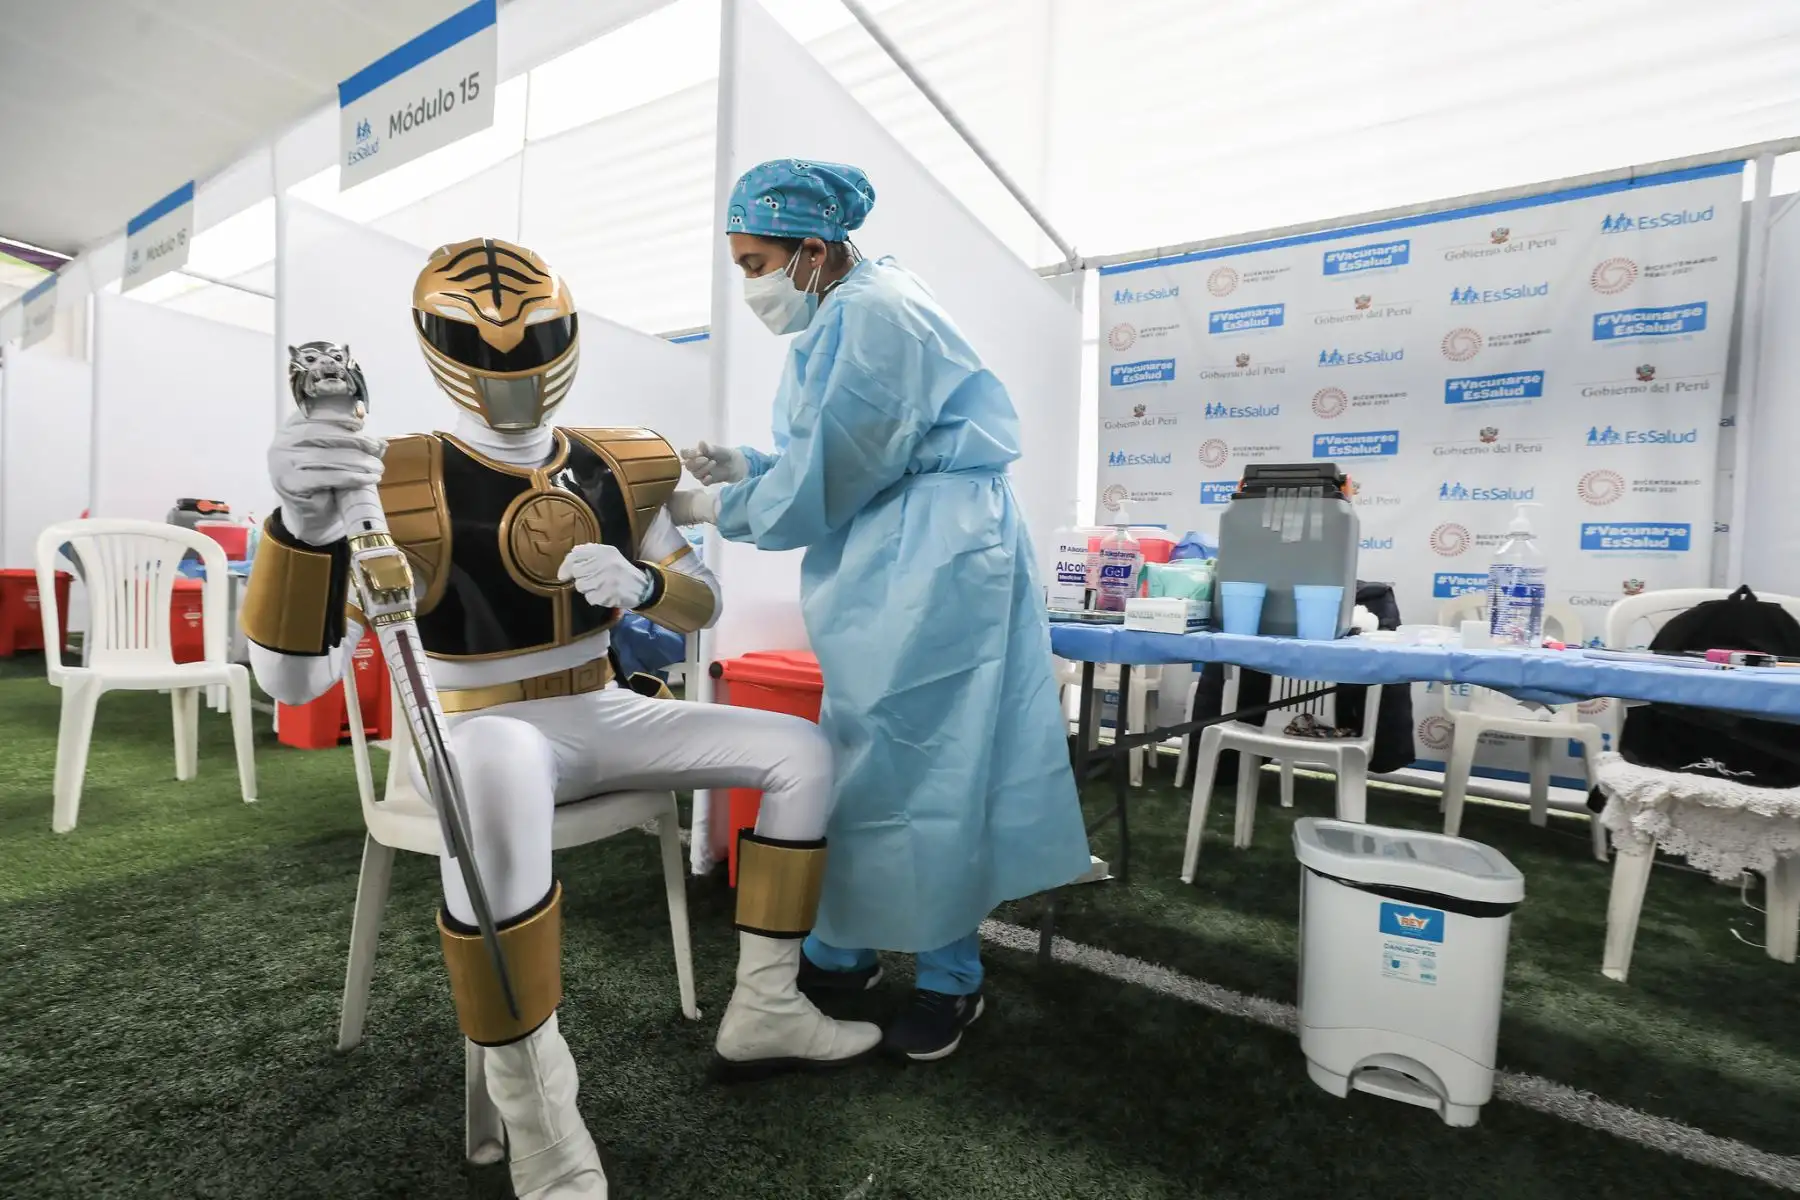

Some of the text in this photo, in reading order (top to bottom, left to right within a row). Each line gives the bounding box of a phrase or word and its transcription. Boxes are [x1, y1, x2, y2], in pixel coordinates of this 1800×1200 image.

[388, 71, 480, 140] Módulo 15
[347, 136, 379, 166] EsSalud
[1638, 205, 1714, 230] EsSalud
[1326, 244, 1407, 263] #Vacunarse
[1445, 247, 1500, 262] Gobierno
[1504, 242, 1524, 254] del
[1338, 255, 1393, 272] EsSalud
[1136, 285, 1180, 303] EsSalud
[1483, 281, 1549, 303] EsSalud
[1212, 307, 1282, 324] #Vacunarse
[1223, 316, 1270, 332] EsSalud
[1314, 313, 1363, 325] Gobierno
[1366, 309, 1383, 319] del
[1598, 306, 1704, 327] #Vacunarse
[1614, 319, 1684, 336] EsSalud
[1347, 347, 1404, 365] EsSalud
[1112, 361, 1174, 376] #Vacunarse
[1200, 370, 1243, 380] Gobierno
[1246, 367, 1260, 377] del
[1122, 371, 1163, 384] EsSalud
[1448, 374, 1542, 392] #Vacunarse
[1463, 384, 1525, 401] EsSalud
[1581, 378, 1711, 399] Gobierno del Perú
[1230, 404, 1281, 418] EsSalud
[1104, 420, 1141, 430] Gobierno
[1142, 417, 1155, 427] del
[1316, 433, 1397, 446] #Vacunarse
[1625, 427, 1698, 445] EsSalud
[1328, 443, 1382, 456] EsSalud
[1433, 445, 1490, 457] Gobierno
[1493, 443, 1511, 454] del
[1128, 451, 1172, 466] EsSalud
[1472, 487, 1535, 502] EsSalud
[1584, 524, 1687, 537] #Vacunarse
[1601, 536, 1670, 549] EsSalud
[1104, 566, 1125, 577] Gel
